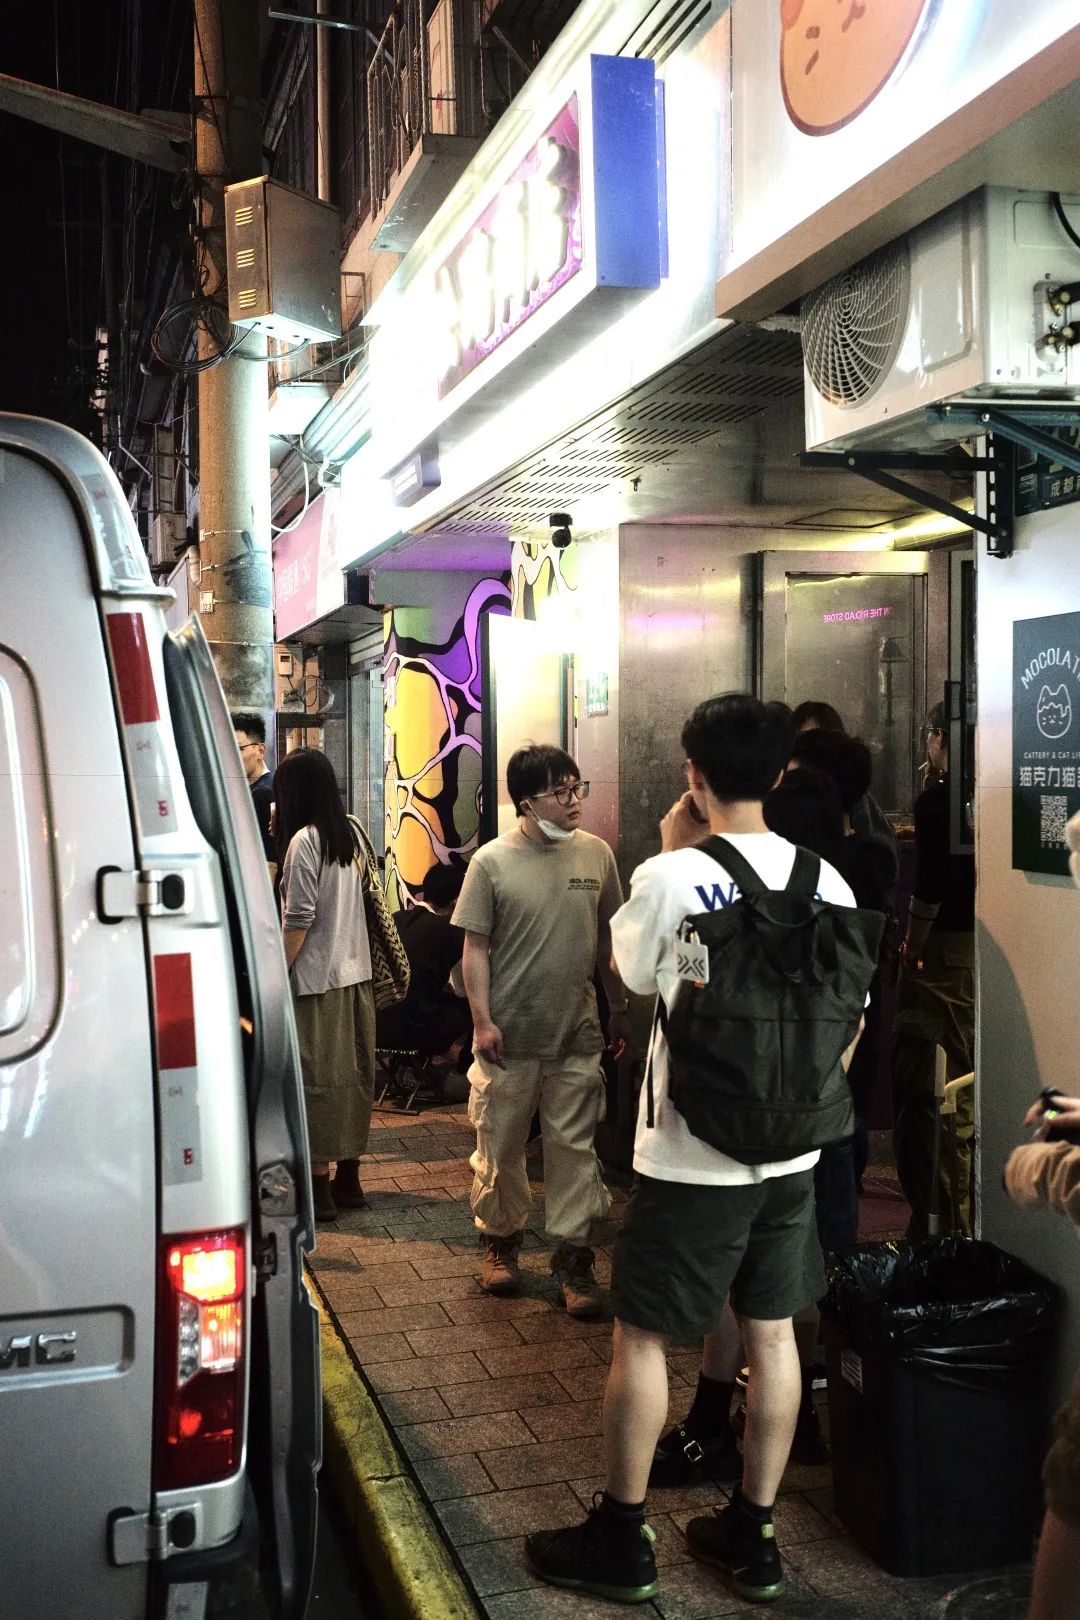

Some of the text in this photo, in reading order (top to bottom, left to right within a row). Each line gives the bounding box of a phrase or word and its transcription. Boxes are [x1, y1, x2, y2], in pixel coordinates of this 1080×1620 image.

[1051, 475, 1080, 498] 成都
[1020, 647, 1080, 690] MOCOLAT
[1024, 751, 1050, 759] CATTERY
[1058, 751, 1070, 759] CAT
